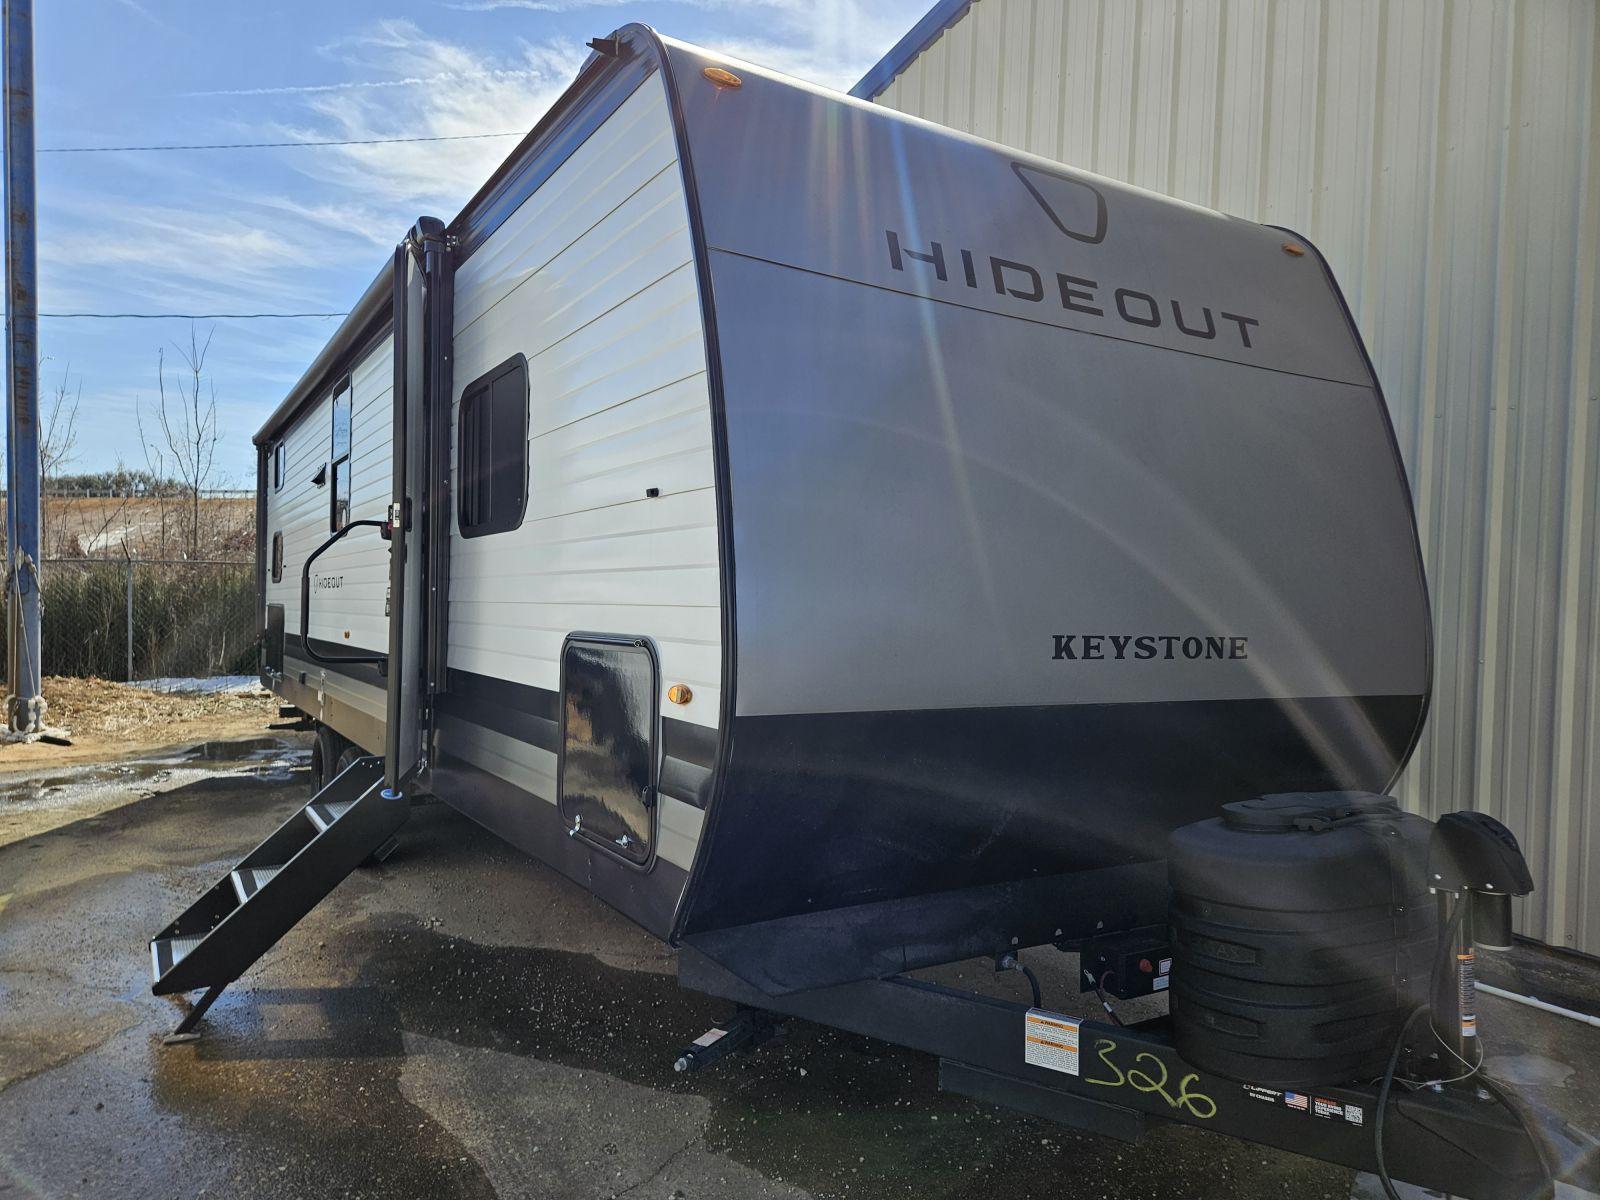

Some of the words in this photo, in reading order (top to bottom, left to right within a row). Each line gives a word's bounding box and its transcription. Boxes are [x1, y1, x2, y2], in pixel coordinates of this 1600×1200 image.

[885, 229, 1260, 349] HIDEOUT
[319, 575, 343, 589] HIDEOUT
[1051, 634, 1249, 660] KEYSTONE
[1083, 1038, 1218, 1119] 326
